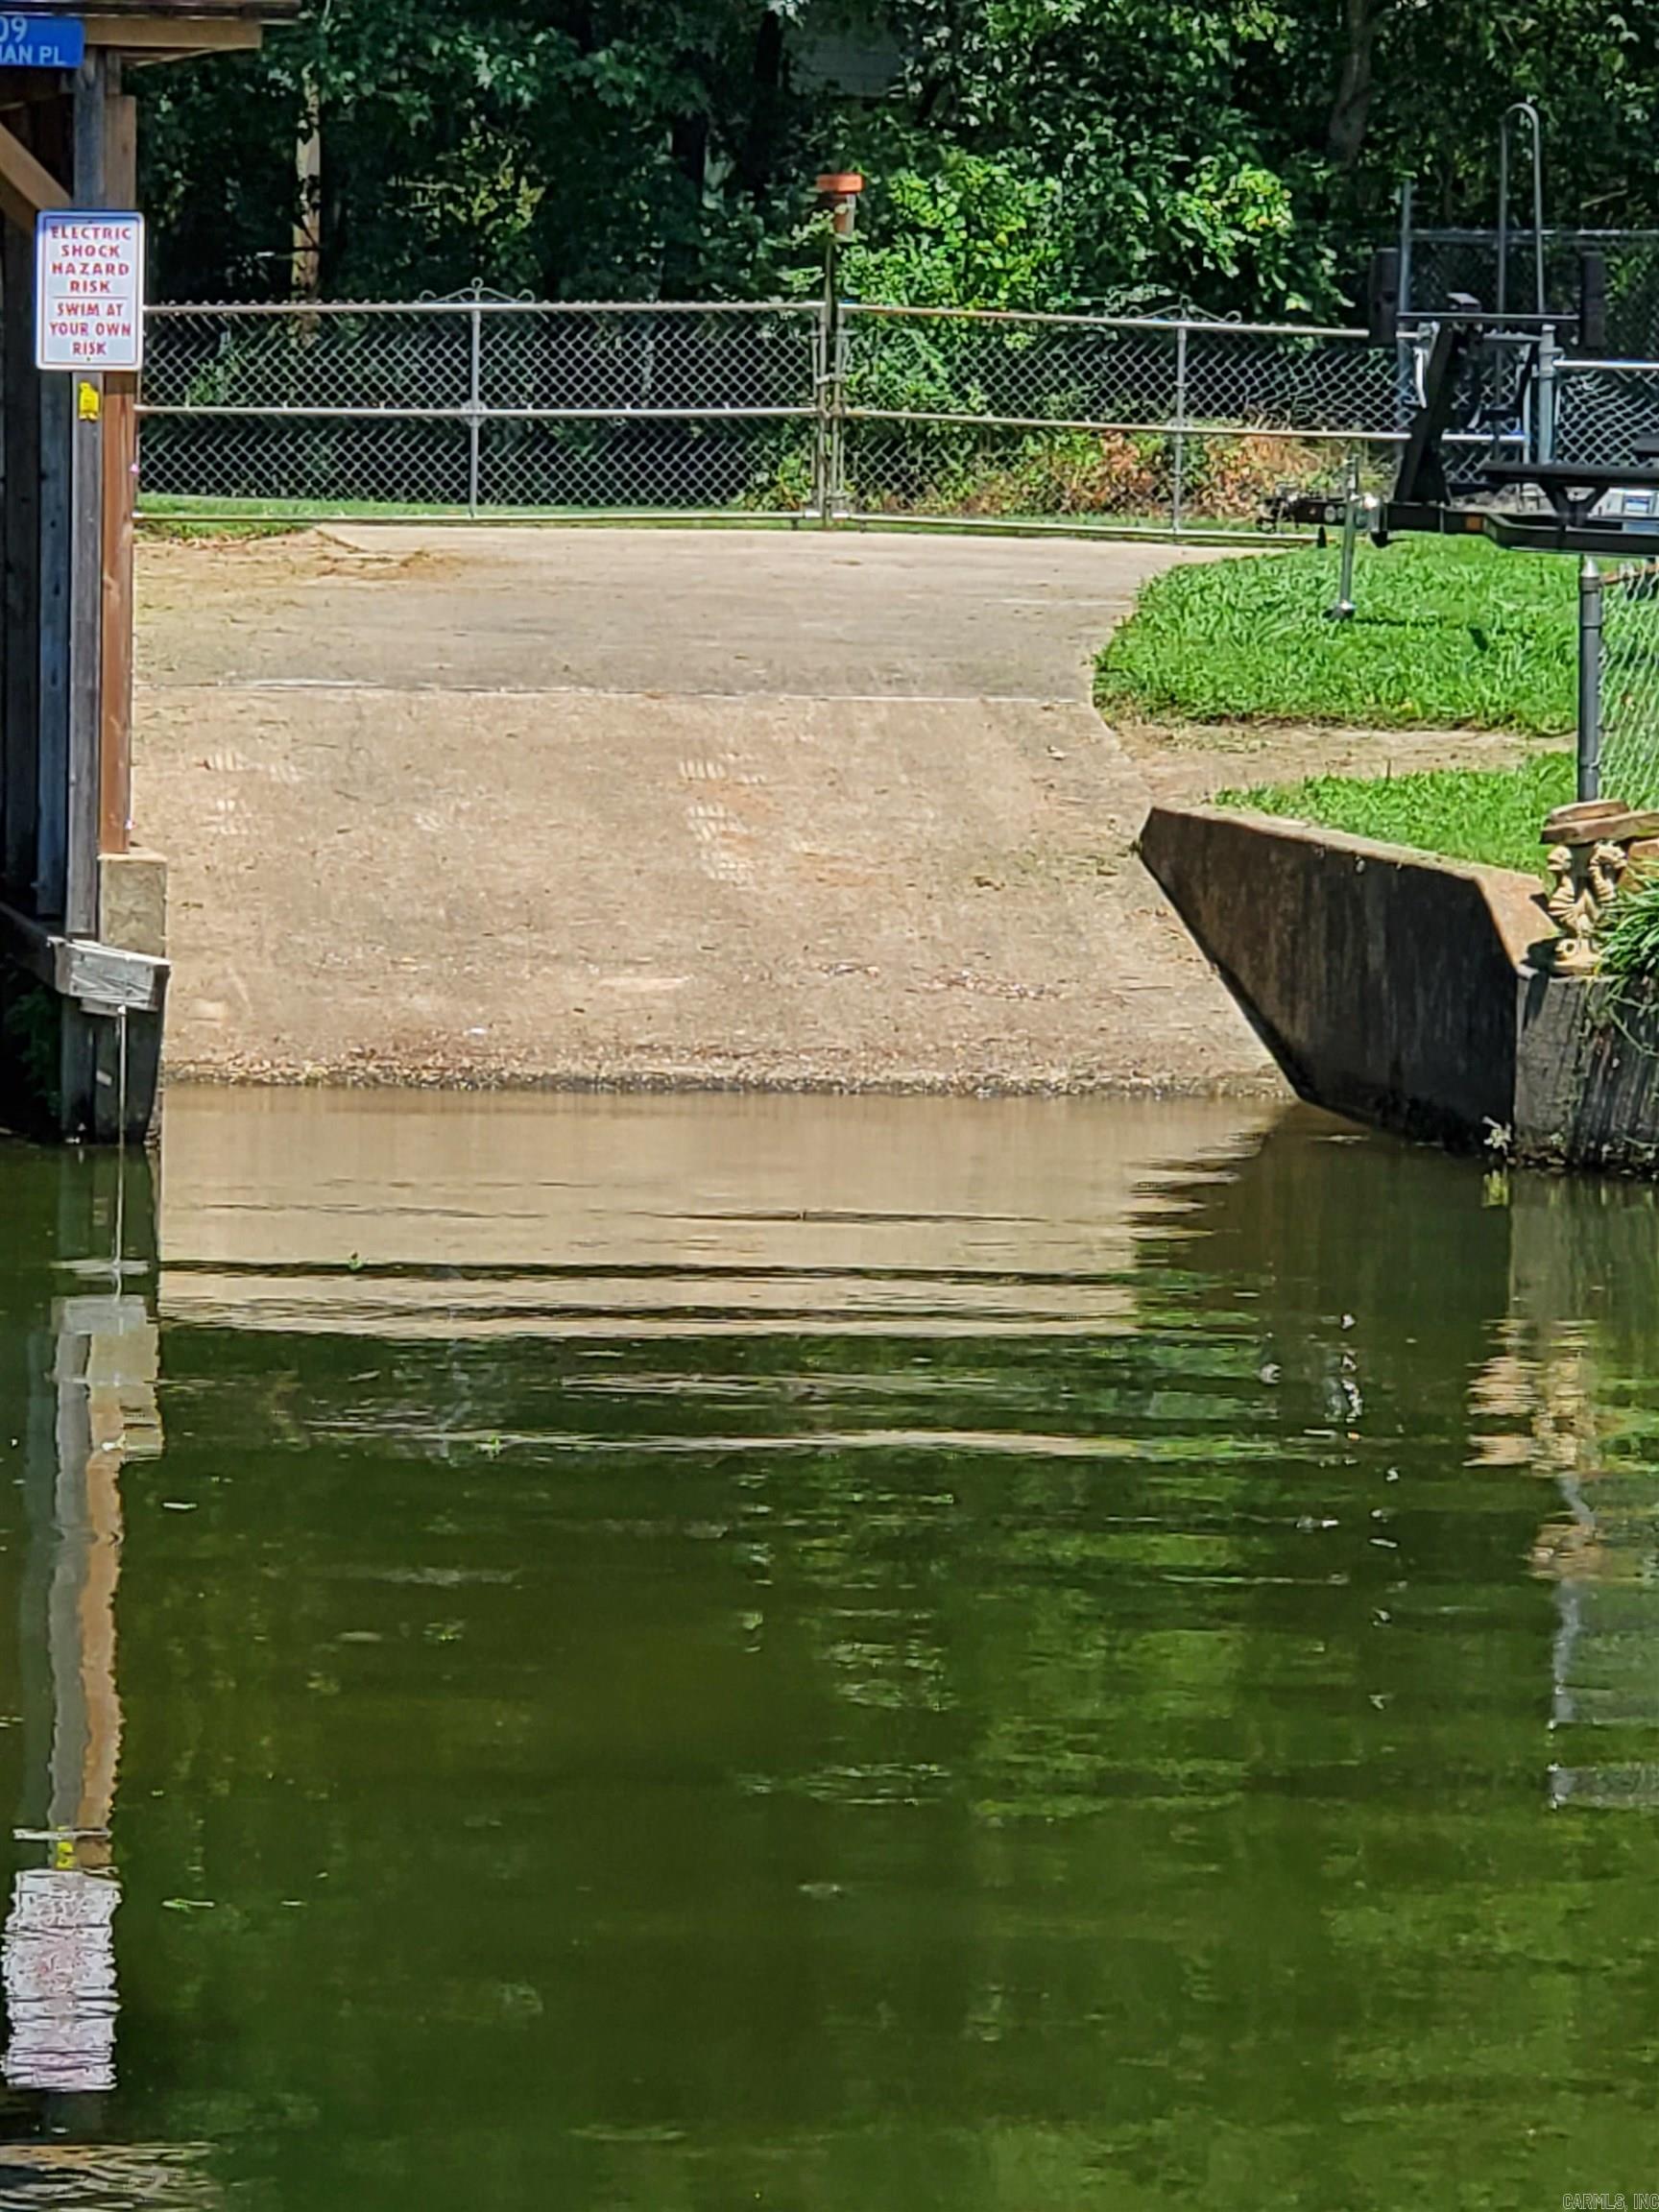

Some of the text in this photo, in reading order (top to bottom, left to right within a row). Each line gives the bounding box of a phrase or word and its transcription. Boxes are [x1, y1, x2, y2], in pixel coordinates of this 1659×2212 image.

[0, 44, 65, 64] AN PL
[51, 225, 131, 239] ELECTRIC
[61, 245, 120, 258] SHOCK
[52, 262, 130, 276] HAZARD
[70, 279, 110, 293] RISK
[58, 302, 123, 316] SWIM AT
[50, 322, 132, 336] YOUR OWN
[72, 342, 107, 355] RISK
